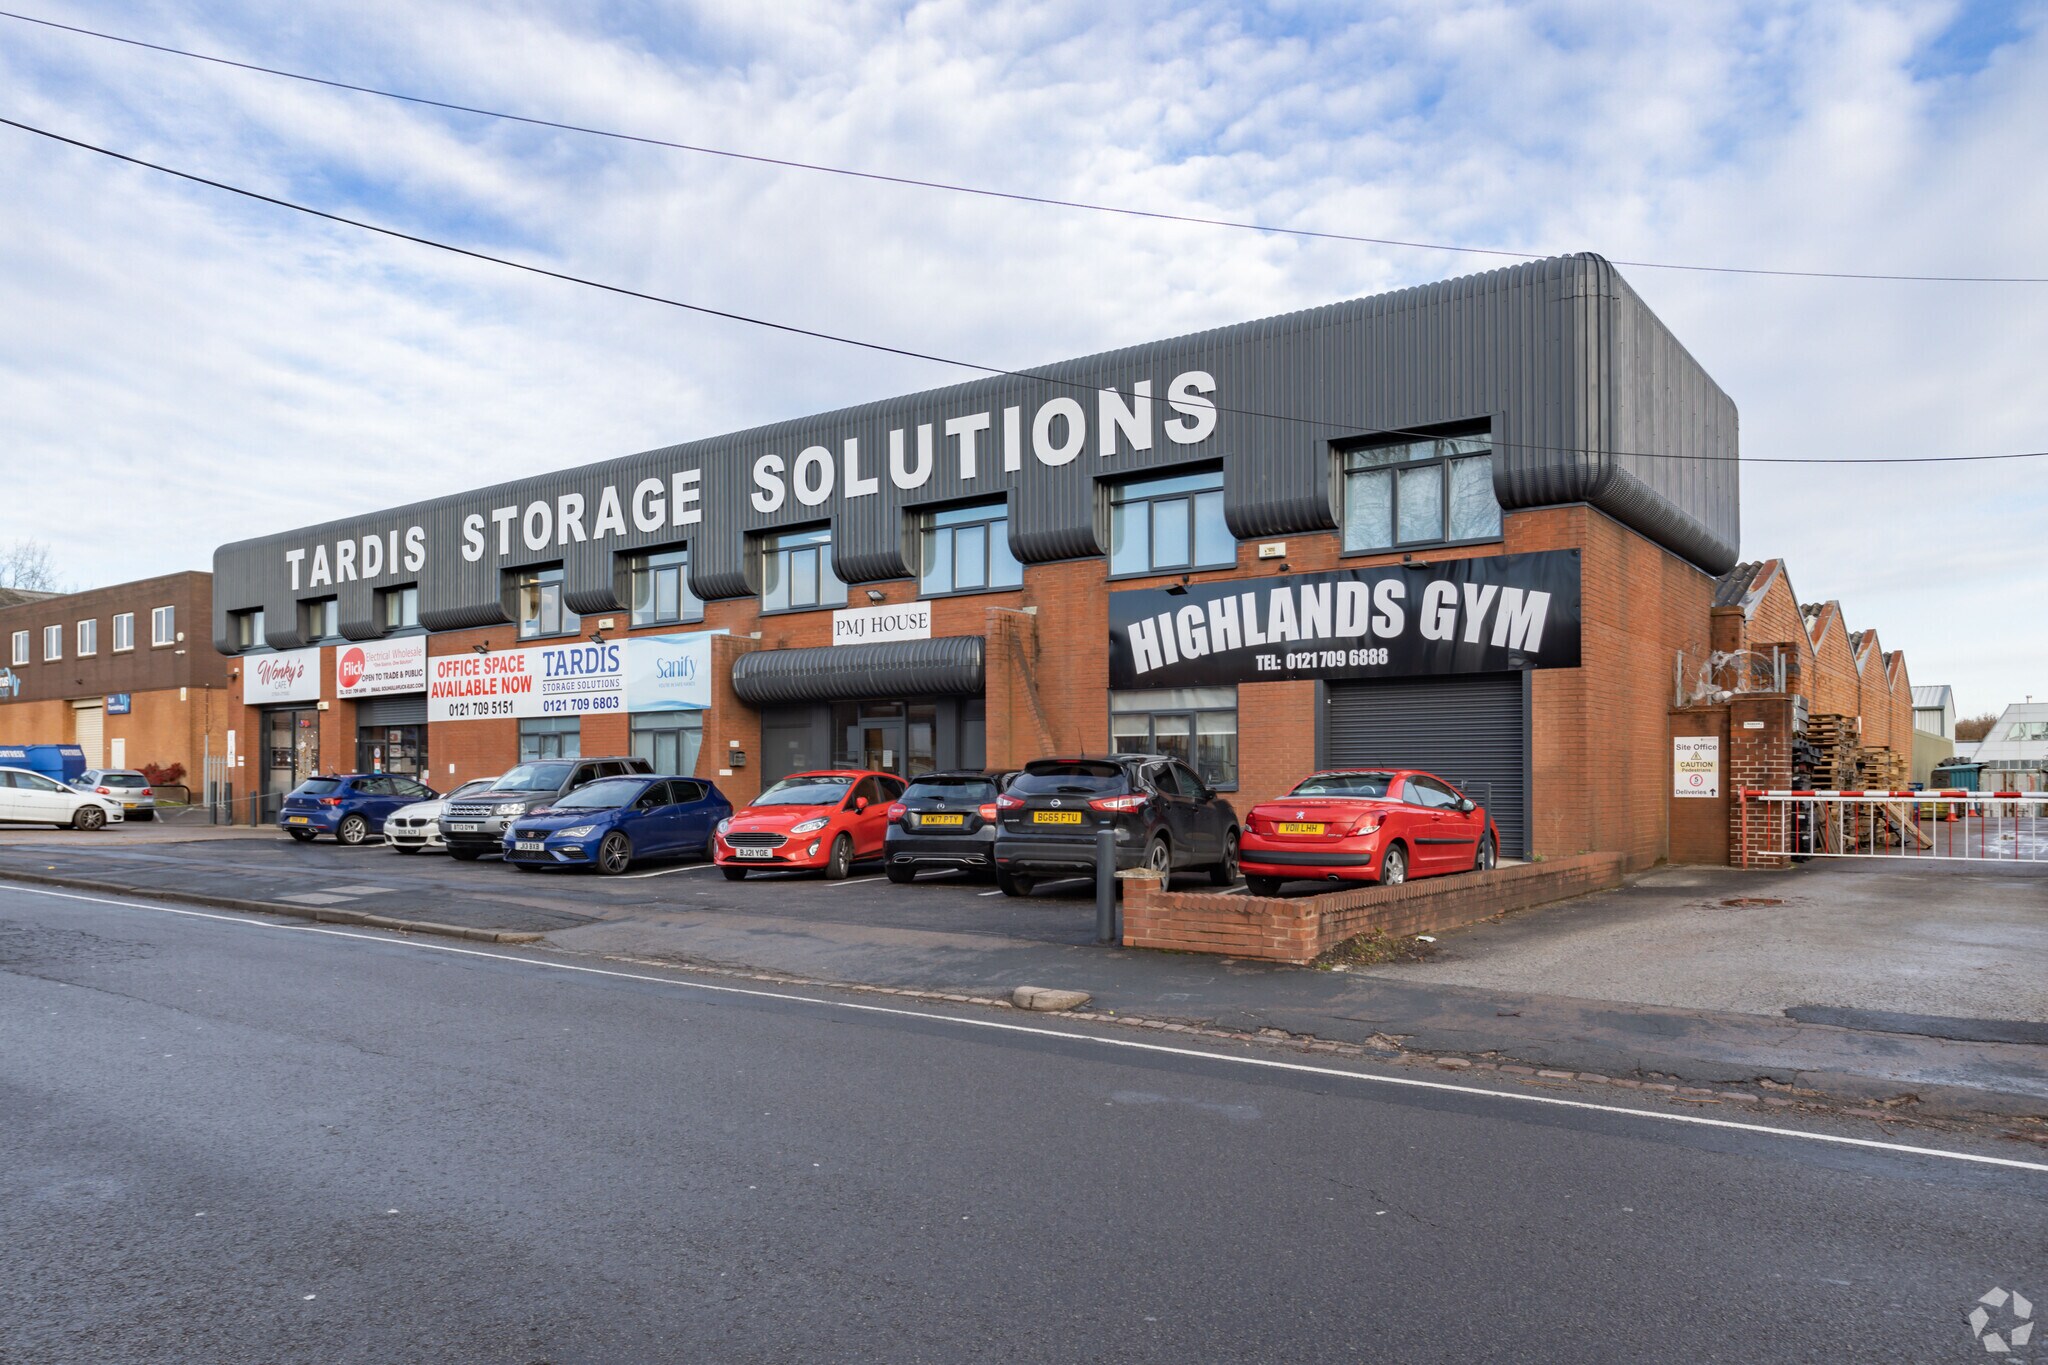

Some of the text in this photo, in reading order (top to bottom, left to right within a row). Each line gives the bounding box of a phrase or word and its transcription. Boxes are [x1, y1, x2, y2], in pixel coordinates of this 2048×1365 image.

[286, 370, 1217, 590] TARDIS STORAGE SOLUTIONS
[836, 612, 928, 637] PMJ HOUSE
[1127, 579, 1552, 675] HIGHLANDS GYM
[343, 660, 363, 676] Flick
[437, 654, 525, 678] OFFICE SPACE
[543, 645, 620, 677] TARDIS
[656, 655, 698, 680] Sanify
[1255, 648, 1389, 671] TEL: 0121 709 6888
[257, 658, 304, 687] Wonky's
[361, 669, 423, 682] OPEN TO TRADE & PUBLIC
[431, 675, 532, 699] AVAILABLE NOW
[542, 678, 620, 692] STORAGE SOLUTIONS
[449, 700, 514, 717] 0121 709 5151
[542, 696, 619, 712] 0121 709 6803
[925, 815, 959, 823] KW17 PTY
[1037, 812, 1078, 822] BG65 FTU
[1300, 823, 1317, 832] LHH
